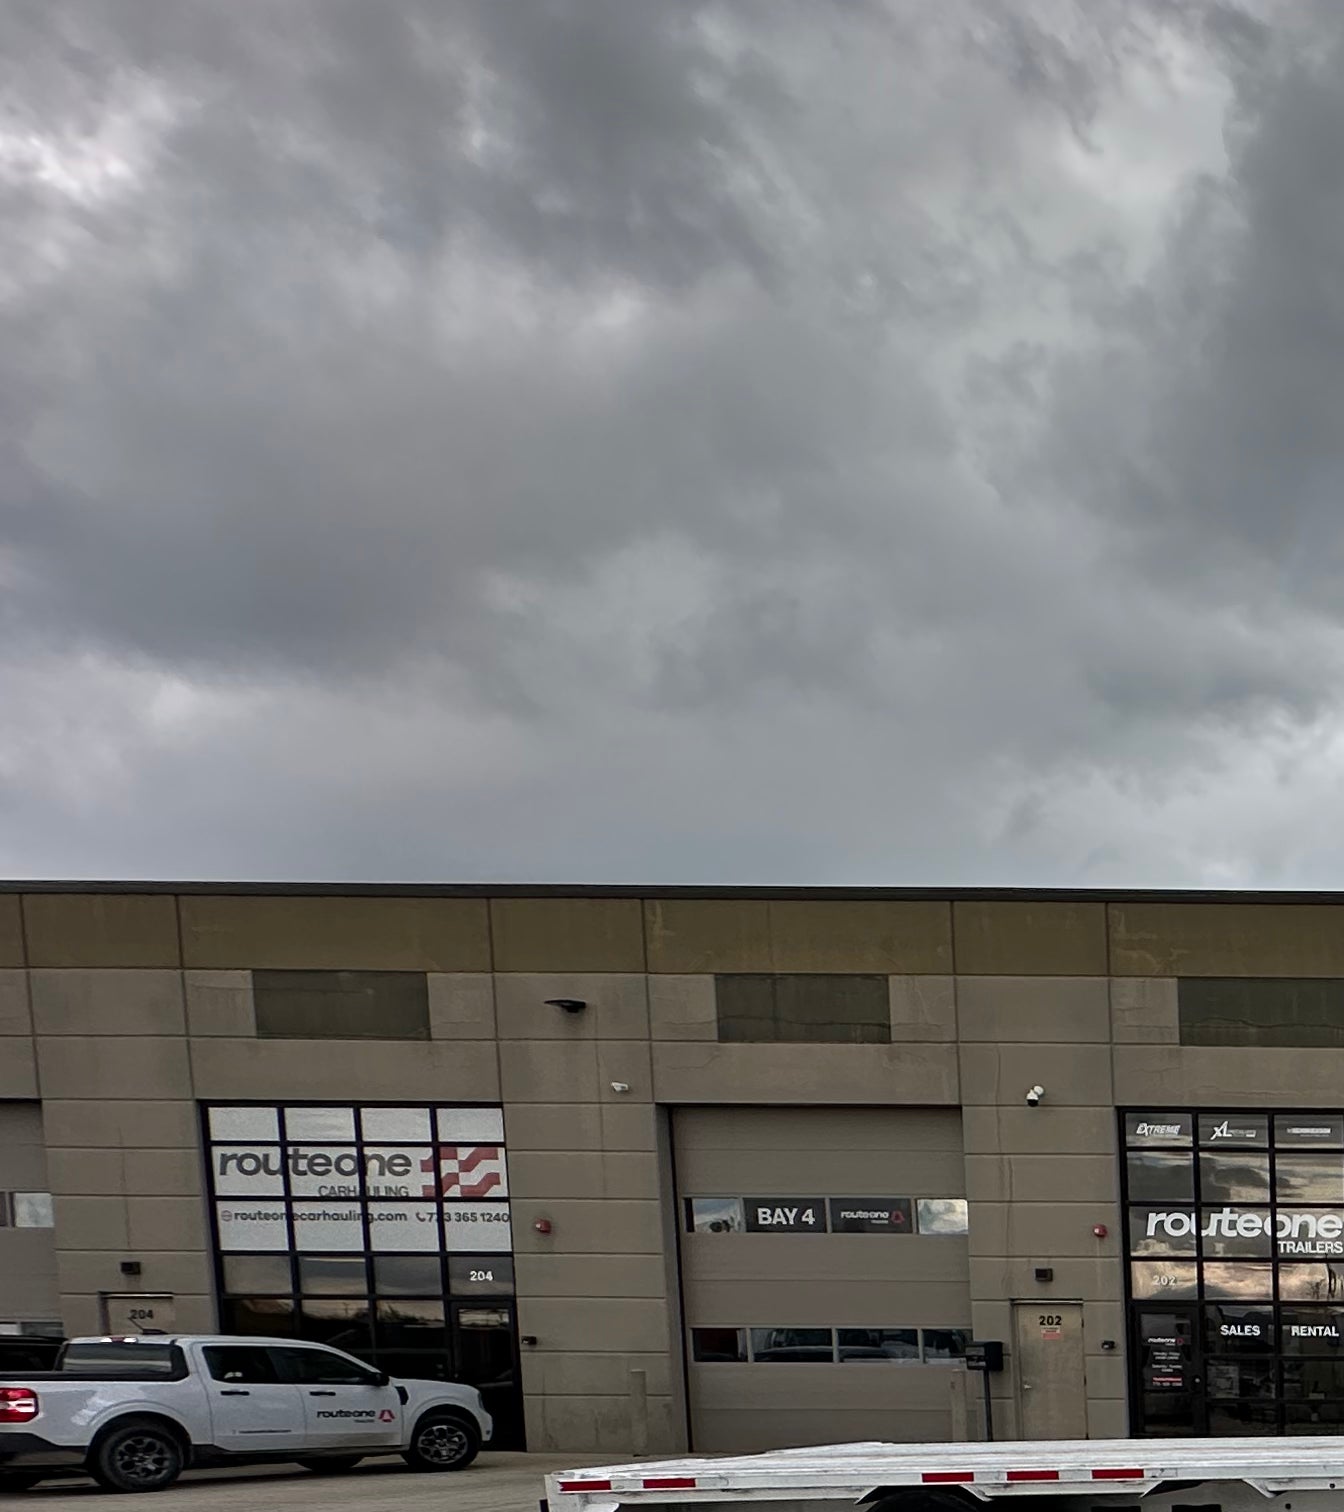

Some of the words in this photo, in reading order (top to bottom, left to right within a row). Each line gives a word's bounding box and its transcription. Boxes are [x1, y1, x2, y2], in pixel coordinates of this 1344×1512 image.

[219, 1147, 412, 1177] routeone
[318, 1185, 409, 1197] CARHULING
[454, 1212, 478, 1223] 365
[480, 1212, 511, 1223] 1240
[757, 1207, 799, 1225] BAY
[801, 1208, 816, 1225] 4
[1146, 1207, 1343, 1238] routeone
[1277, 1240, 1344, 1255] TRAILERS
[469, 1270, 494, 1281] 204
[1152, 1275, 1177, 1286] 202
[130, 1309, 154, 1320] 204
[1039, 1315, 1062, 1326] 202
[1220, 1325, 1261, 1336] SALES
[1291, 1326, 1340, 1337] RENTAL
[316, 1409, 376, 1418] routeone
